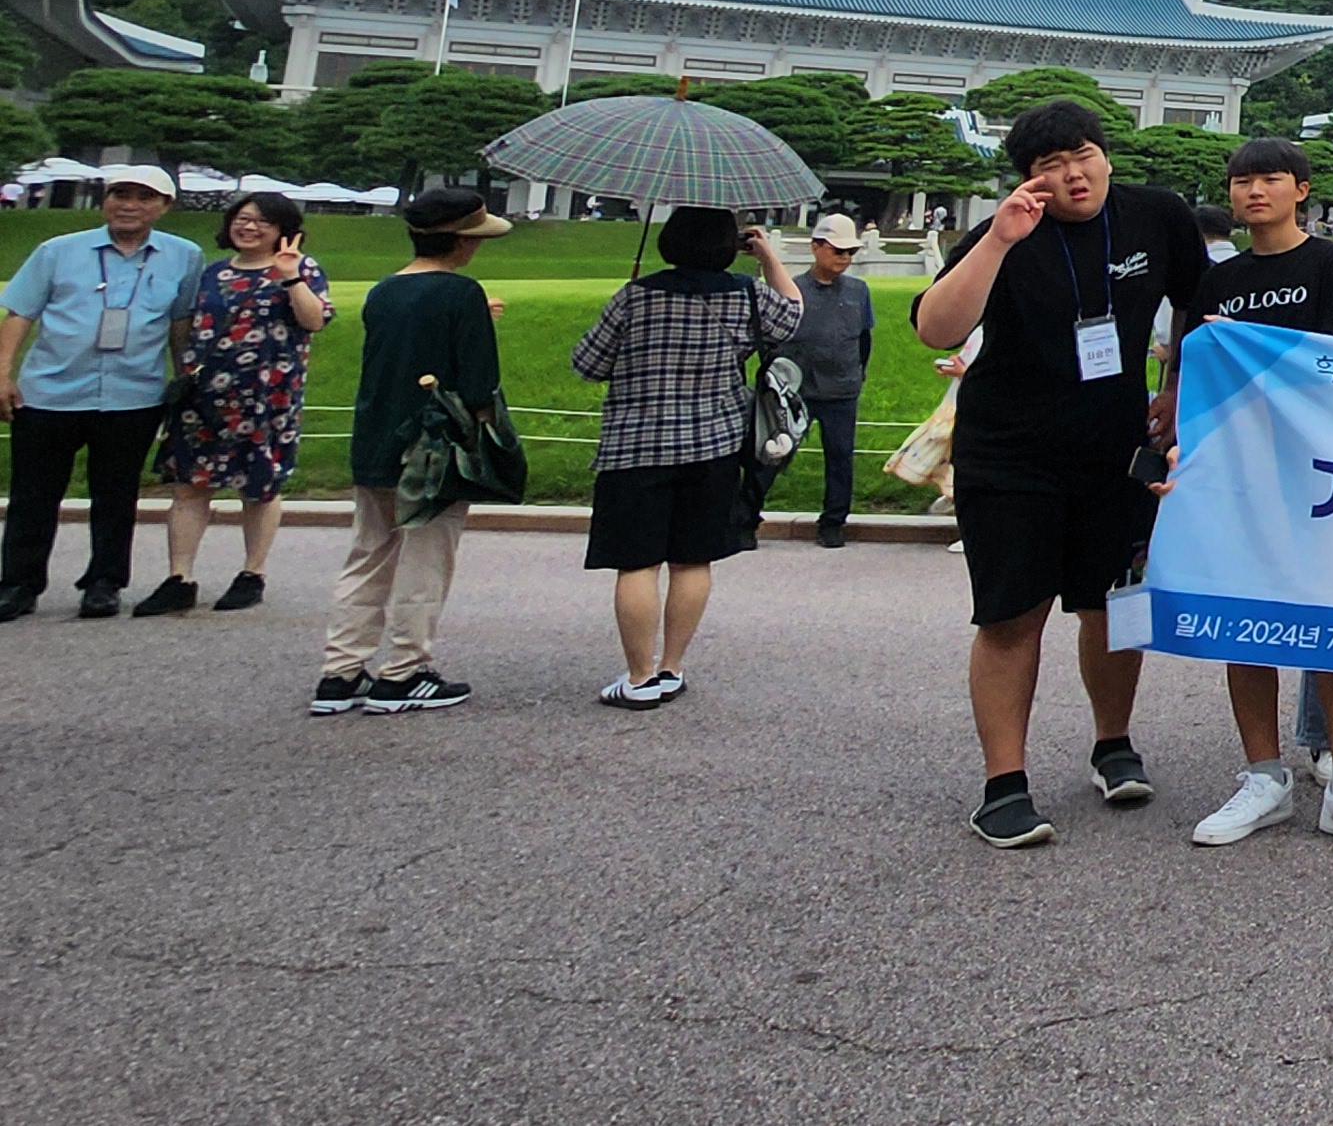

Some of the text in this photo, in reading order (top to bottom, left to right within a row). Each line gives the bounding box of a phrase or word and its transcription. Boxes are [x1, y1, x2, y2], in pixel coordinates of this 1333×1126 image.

[1218, 286, 1307, 316] NO LOGO
[1174, 613, 1222, 640] 일시
[1235, 618, 1320, 649] 2024년
